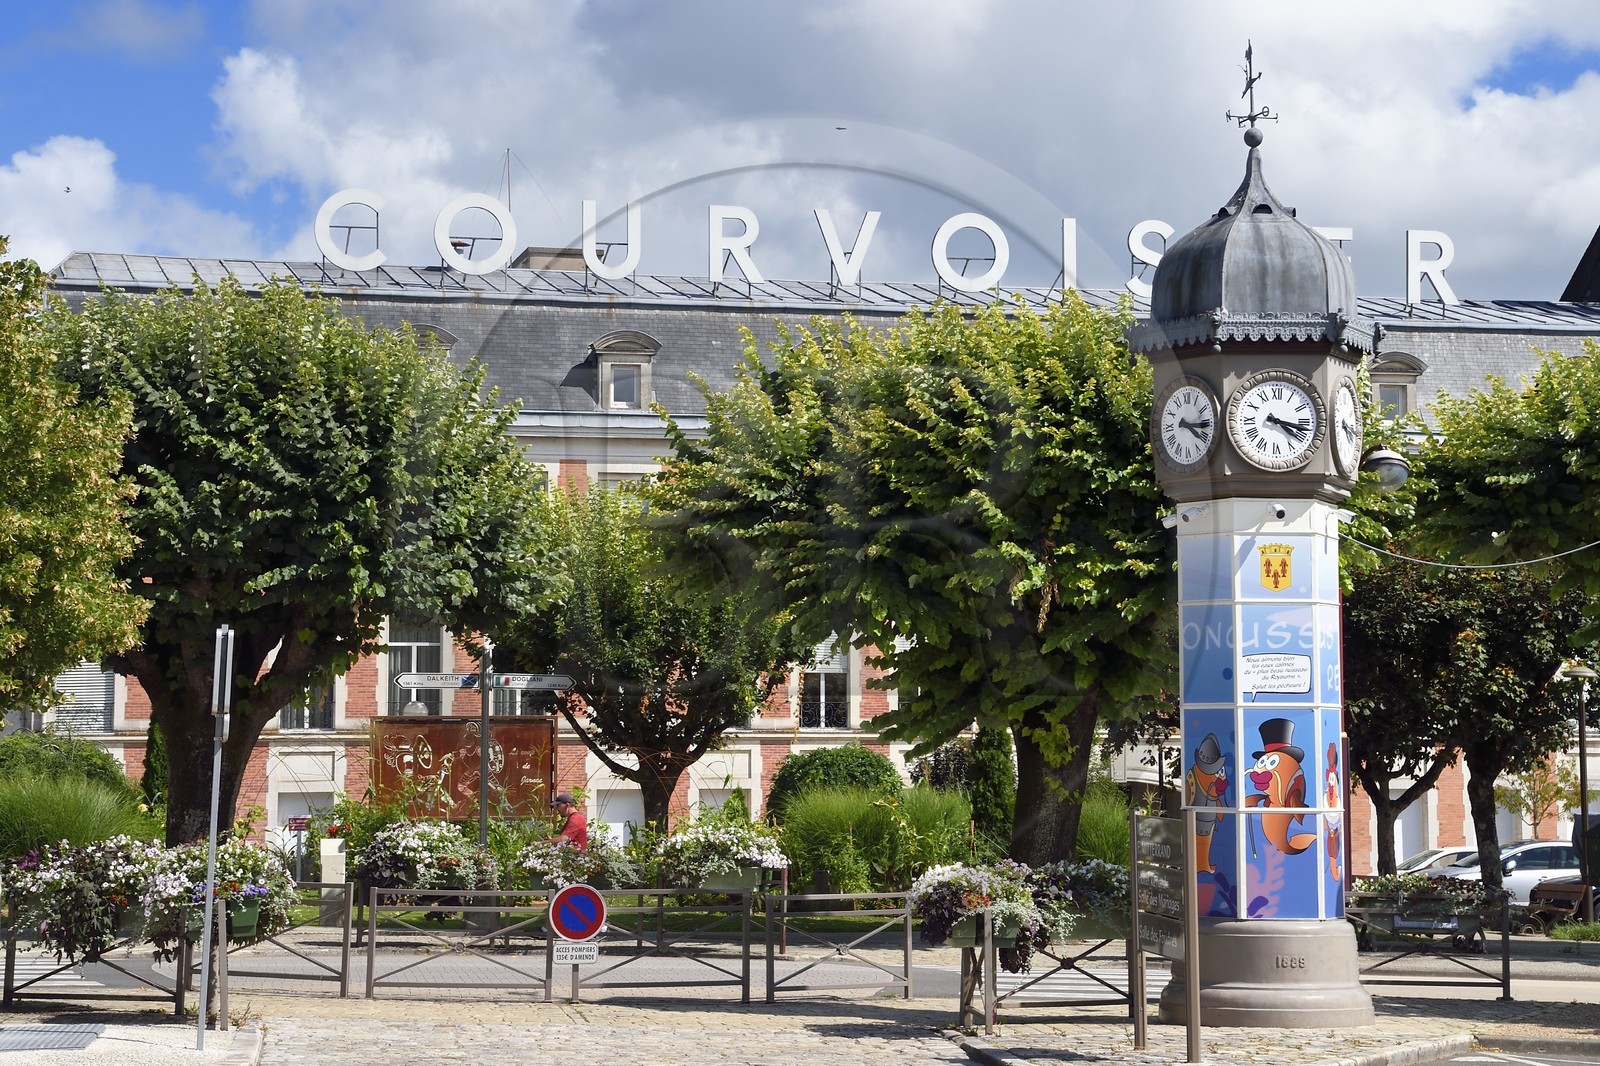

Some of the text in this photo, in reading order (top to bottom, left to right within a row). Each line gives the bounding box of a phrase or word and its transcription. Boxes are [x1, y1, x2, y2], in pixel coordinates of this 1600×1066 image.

[314, 187, 1460, 306] COURVOISR
[1256, 390, 1270, 404] XI
[1271, 388, 1283, 400] XII
[1287, 392, 1294, 403] I
[1247, 402, 1260, 412] X
